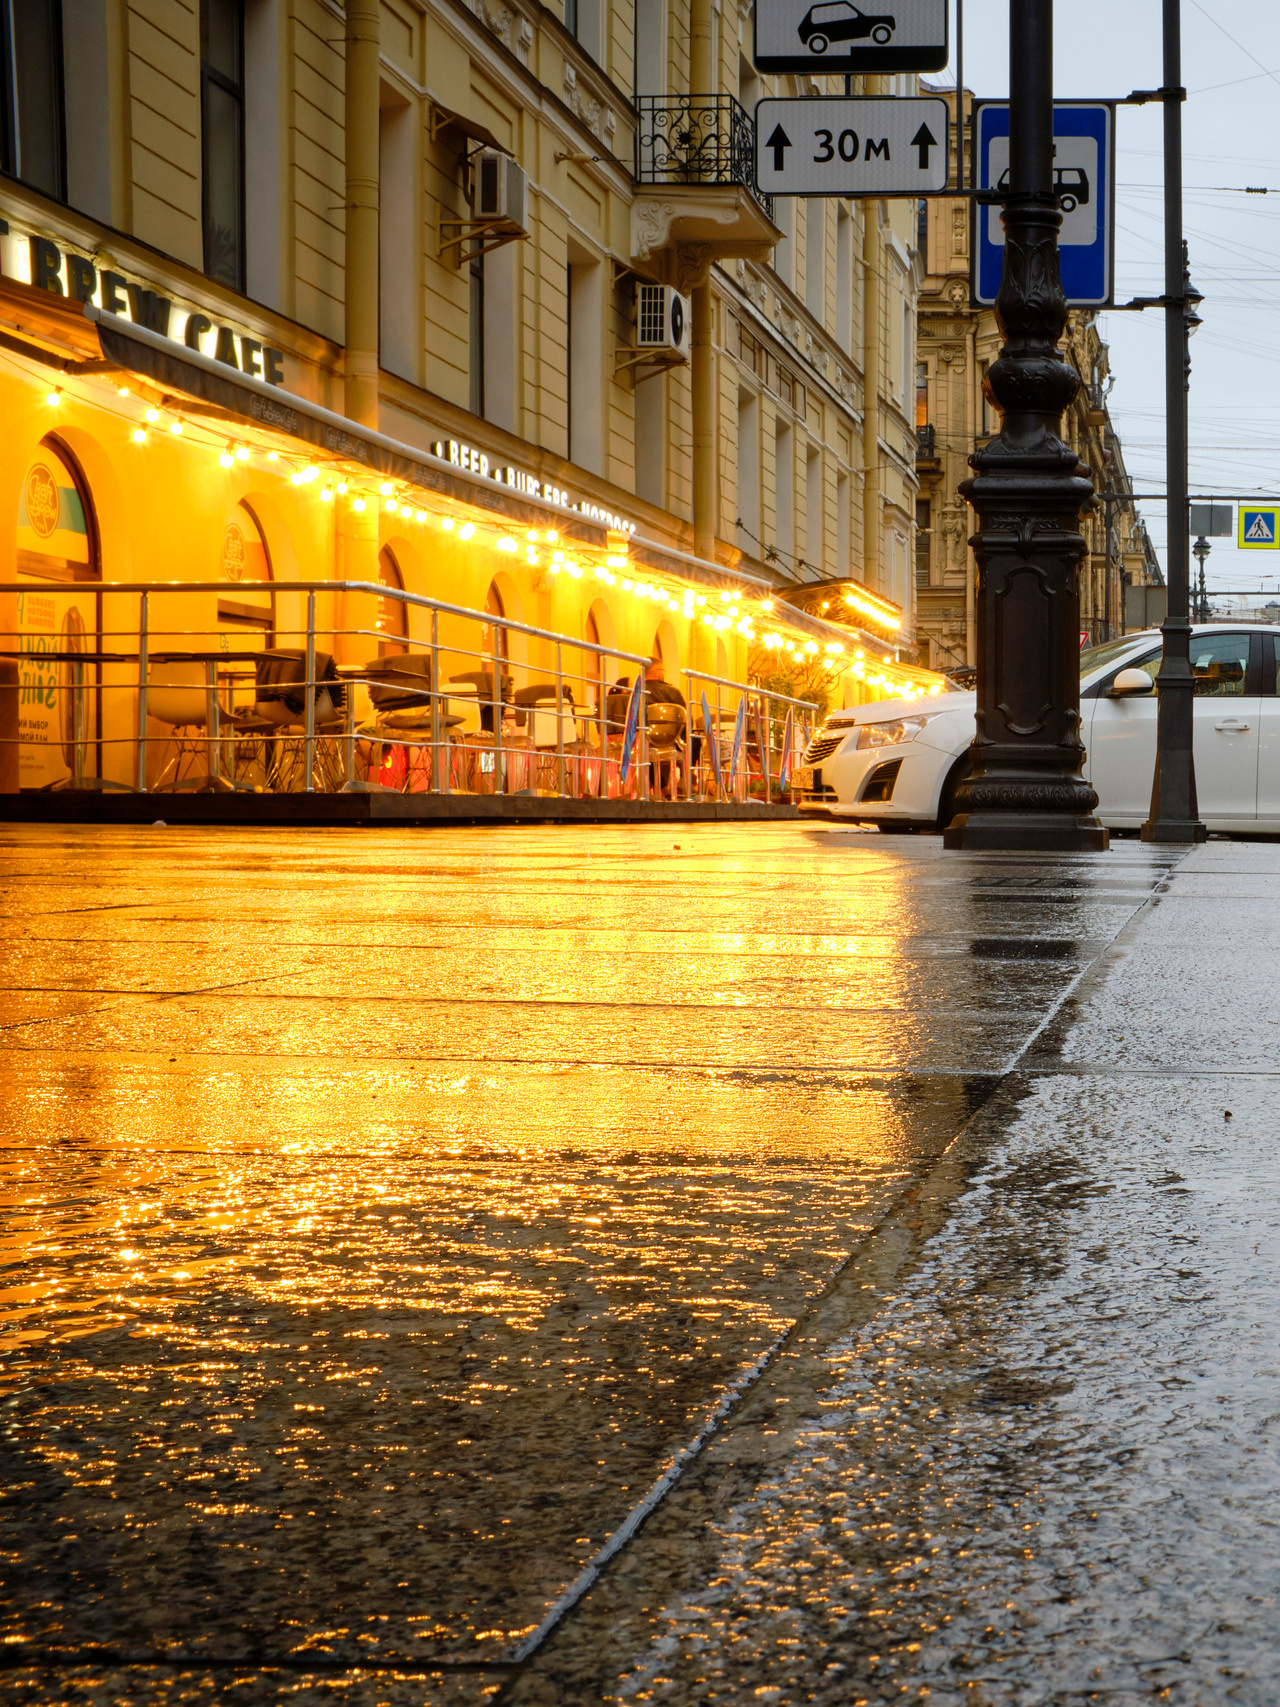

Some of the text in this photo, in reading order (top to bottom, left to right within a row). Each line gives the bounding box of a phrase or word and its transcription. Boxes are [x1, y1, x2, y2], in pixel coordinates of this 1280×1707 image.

[29, 235, 284, 386] BREW CAFE
[447, 439, 489, 478] BEER
[28, 719, 49, 730] ВЫБОР
